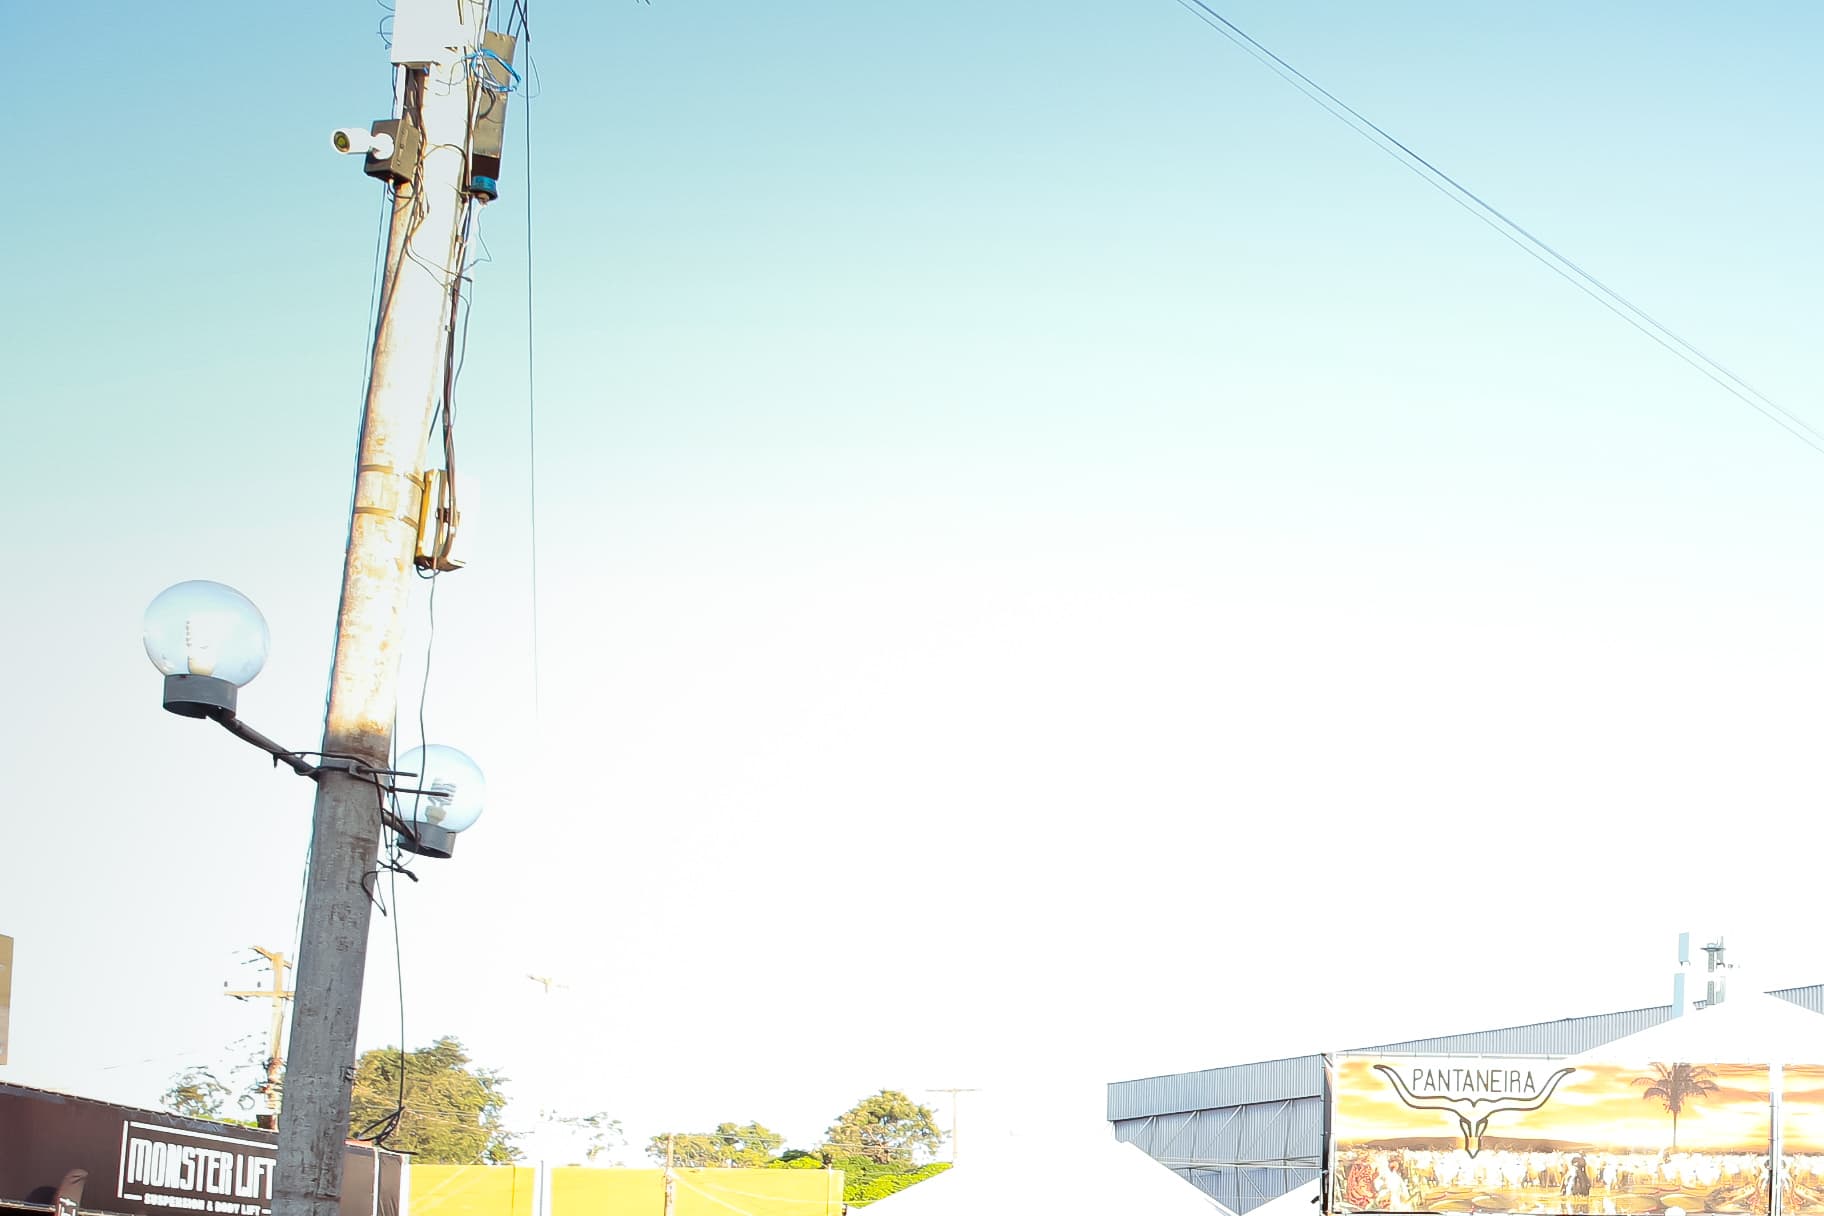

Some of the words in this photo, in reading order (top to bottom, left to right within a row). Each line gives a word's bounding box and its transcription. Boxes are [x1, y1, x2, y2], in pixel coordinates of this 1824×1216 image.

[1412, 1067, 1537, 1094] PANTANEIRA
[128, 1137, 234, 1196] MONSTER
[235, 1154, 277, 1200] LIFT
[144, 1193, 205, 1211] SUSPENSION
[214, 1201, 240, 1215] BODY
[241, 1204, 262, 1216] LIFT
